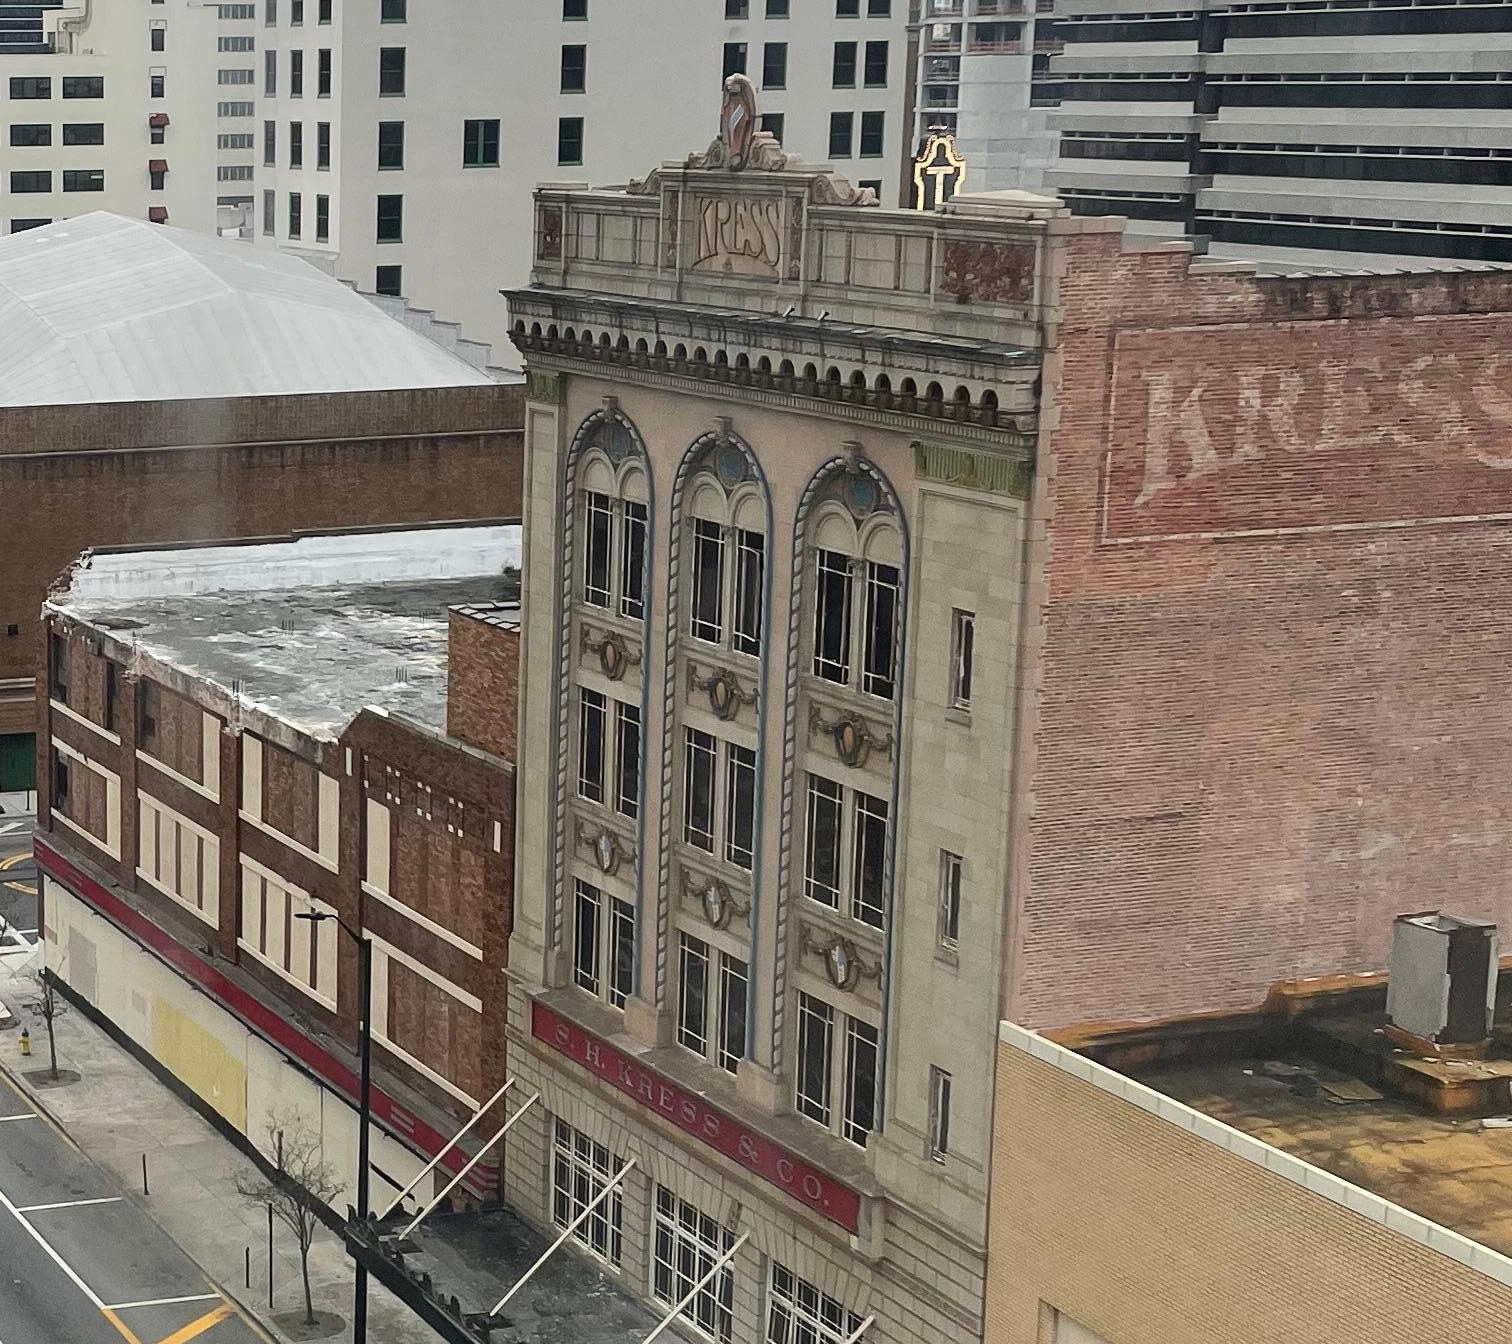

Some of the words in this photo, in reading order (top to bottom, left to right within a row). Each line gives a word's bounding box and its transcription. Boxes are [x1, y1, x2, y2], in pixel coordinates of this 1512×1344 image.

[694, 197, 781, 268] KRESS
[555, 1024, 575, 1049] S.
[585, 1039, 606, 1069] H.
[617, 1059, 720, 1137] KRESS
[738, 1135, 759, 1164] &
[775, 1158, 829, 1206] CO.
